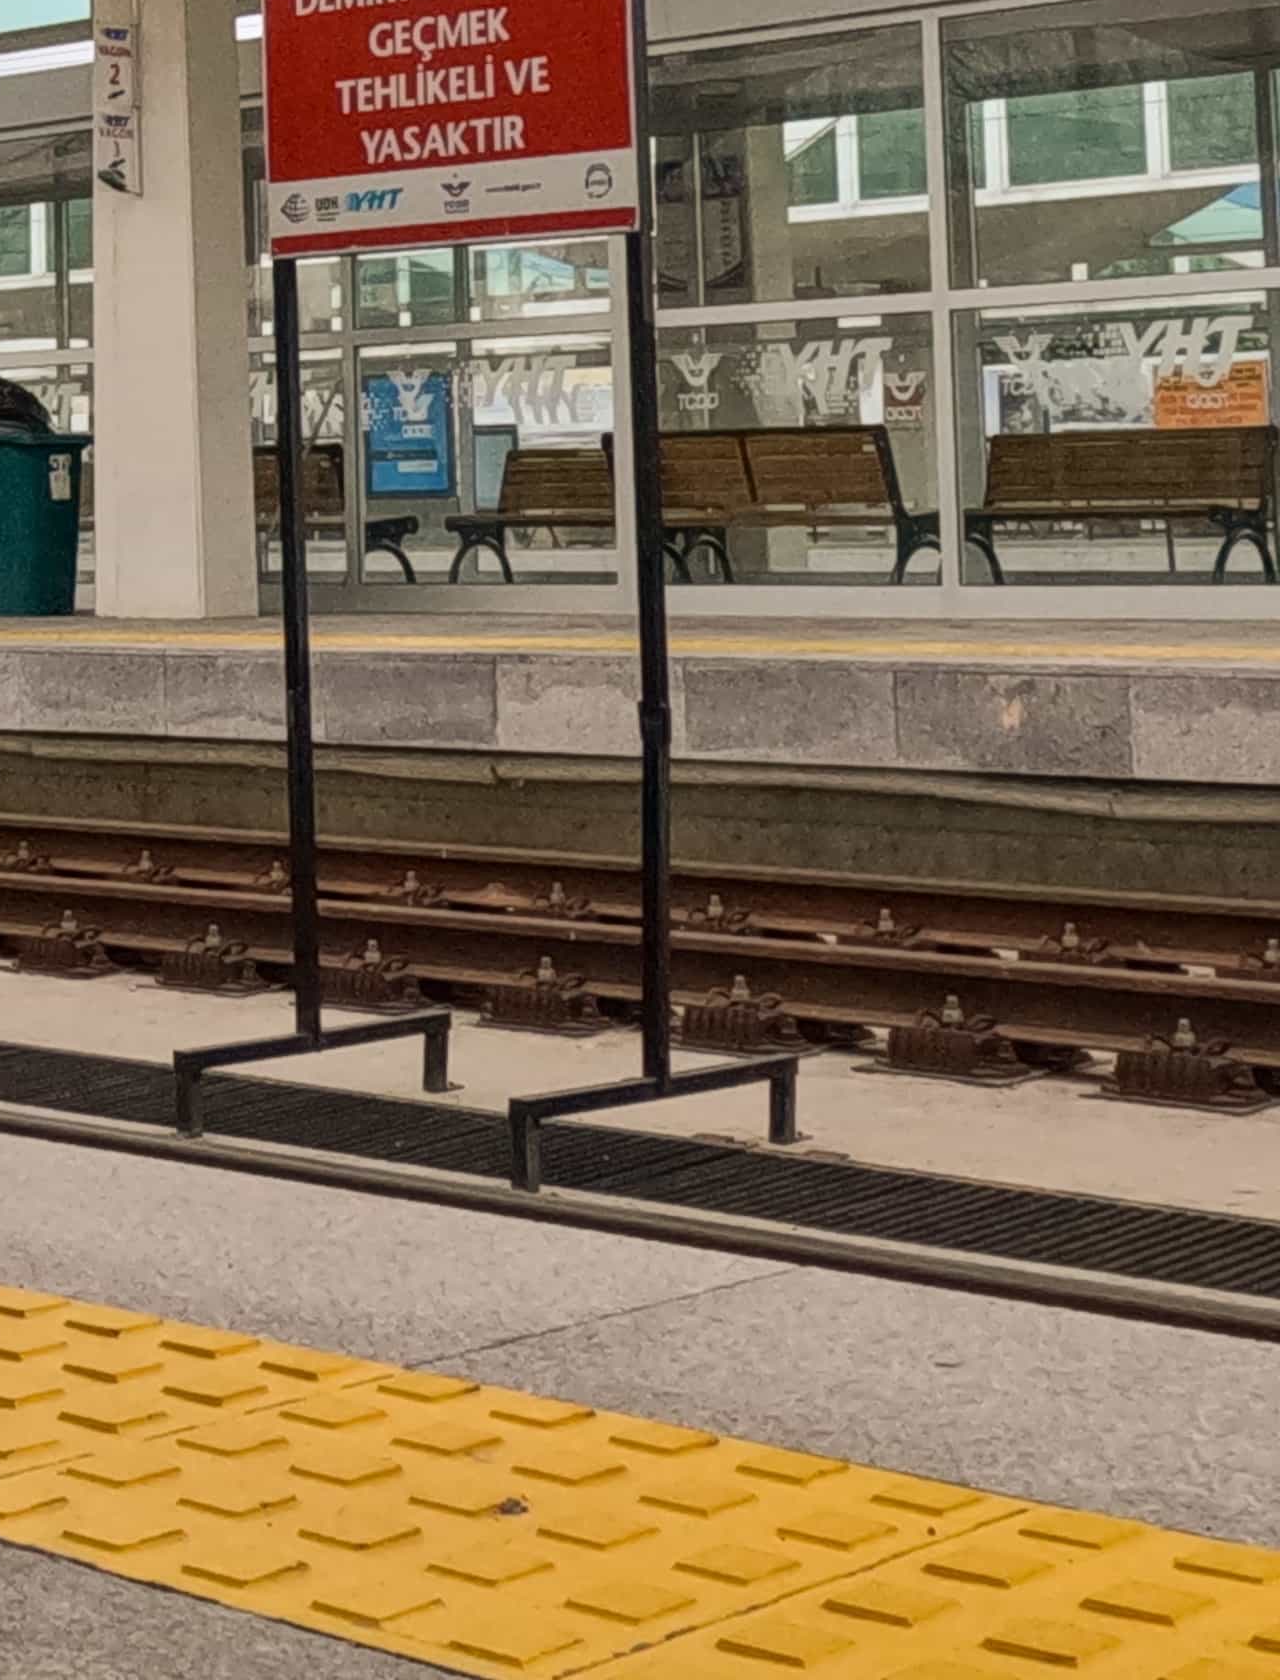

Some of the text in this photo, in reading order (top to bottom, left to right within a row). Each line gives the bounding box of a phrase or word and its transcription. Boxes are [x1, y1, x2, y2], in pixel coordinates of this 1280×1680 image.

[368, 7, 510, 61] GEÇMEK
[336, 54, 551, 115] TEHLİKELİ VE
[361, 115, 526, 164] YASAKTIR
[349, 187, 405, 212] YHT
[1119, 316, 1254, 384] YHT
